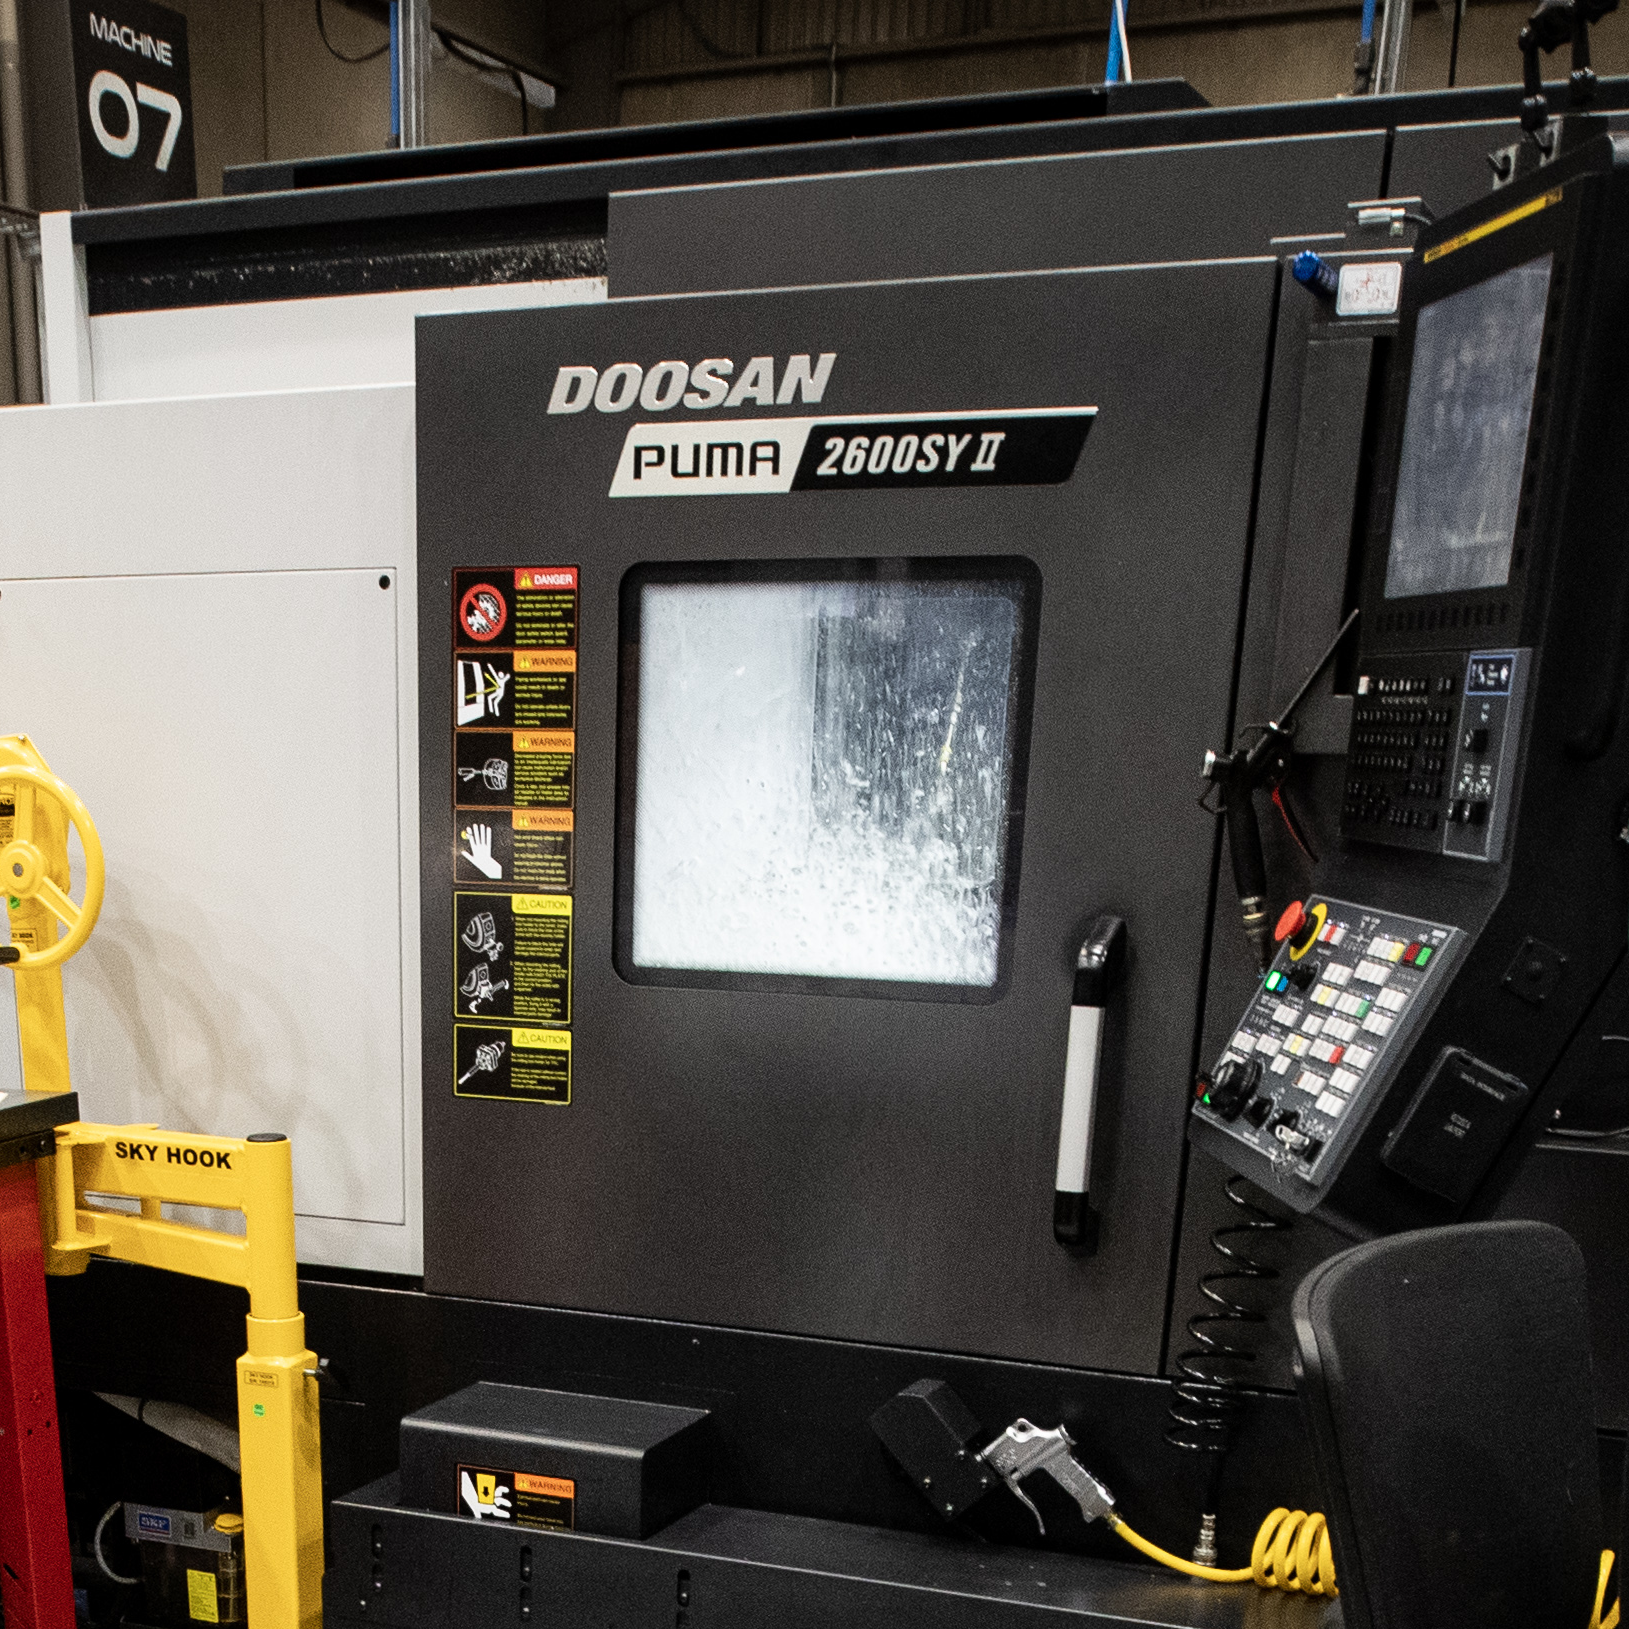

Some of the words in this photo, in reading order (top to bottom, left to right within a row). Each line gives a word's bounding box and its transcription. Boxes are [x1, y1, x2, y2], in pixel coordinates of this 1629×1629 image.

[90, 12, 173, 67] MACHINE
[89, 70, 182, 172] 07
[546, 353, 837, 415] DOOSAN
[632, 440, 781, 481] PUMA
[533, 573, 573, 586] DANGER
[531, 656, 574, 667] WARNING
[530, 737, 572, 747] WARNING
[530, 816, 572, 826] WARNING
[529, 900, 567, 910] CAUTION
[529, 1034, 568, 1045] CAUTION
[115, 1142, 159, 1162] SKY
[167, 1146, 233, 1170] HOOK
[529, 1479, 573, 1494] WARNING
[141, 1516, 167, 1529] SKF
